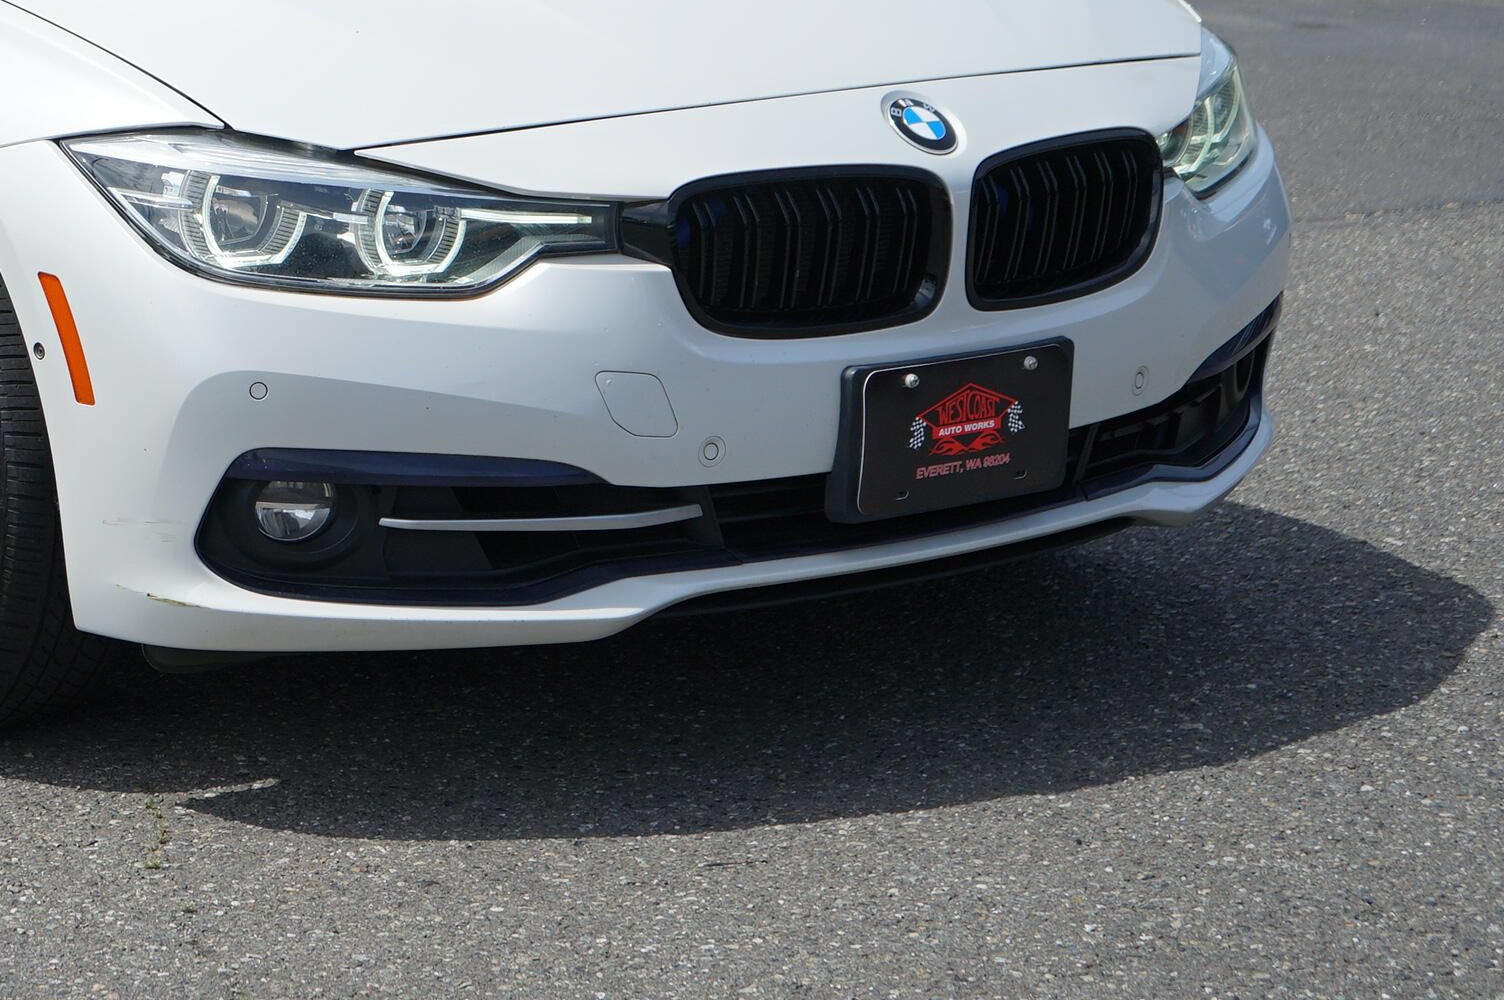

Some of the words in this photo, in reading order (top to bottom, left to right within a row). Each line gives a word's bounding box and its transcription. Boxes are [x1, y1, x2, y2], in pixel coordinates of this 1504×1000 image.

[939, 426, 962, 437] AUTO
[964, 420, 995, 432] WORKS
[916, 461, 964, 480] EVERETT,
[965, 459, 982, 471] WA
